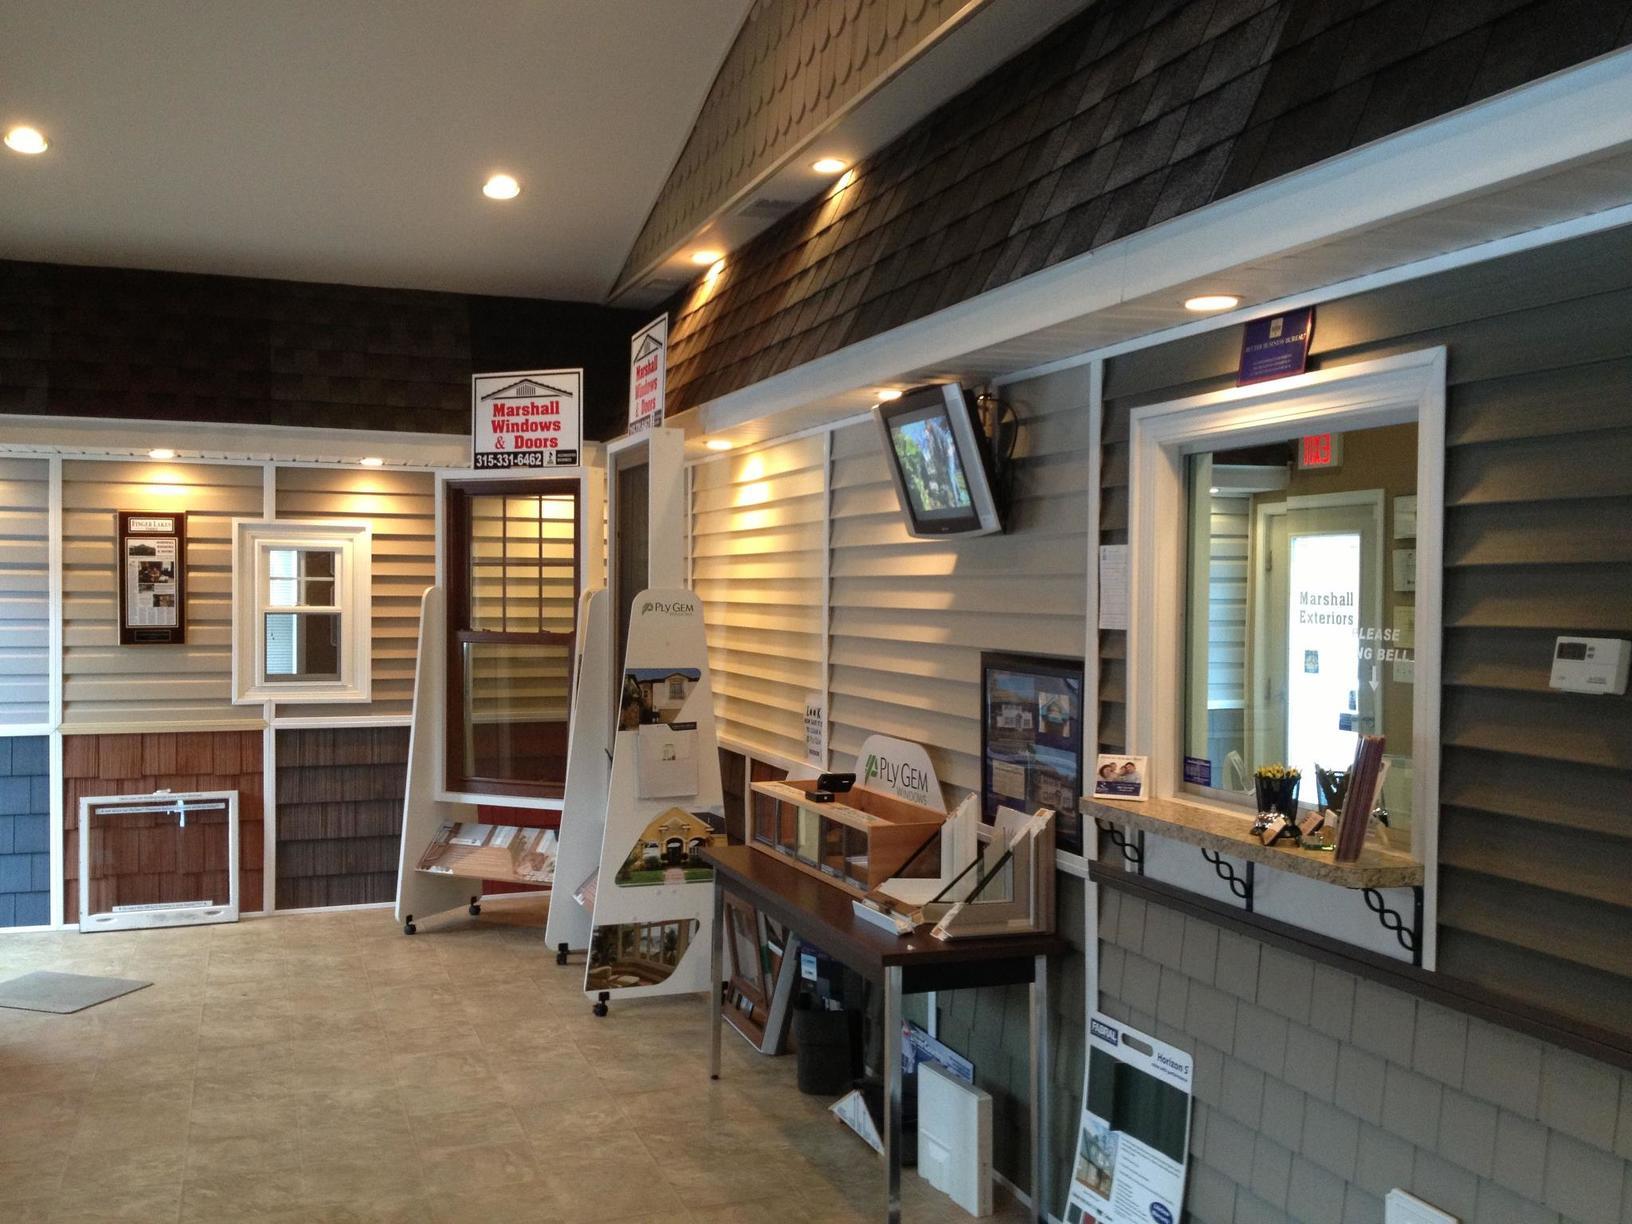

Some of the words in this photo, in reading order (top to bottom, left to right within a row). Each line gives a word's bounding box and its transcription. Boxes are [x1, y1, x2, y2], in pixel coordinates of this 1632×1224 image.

[493, 401, 560, 417] Marshall
[491, 419, 561, 433] Windows
[495, 435, 505, 449] &
[514, 435, 558, 449] Doors
[476, 453, 542, 467] 315-331-6462
[1300, 592, 1354, 606] Marshall
[1300, 609, 1354, 625] Exteriors
[1376, 648, 1410, 662] BELL
[879, 757, 900, 789] PLY
[901, 763, 928, 793] GEM
[1157, 1052, 1183, 1072] Horizon
